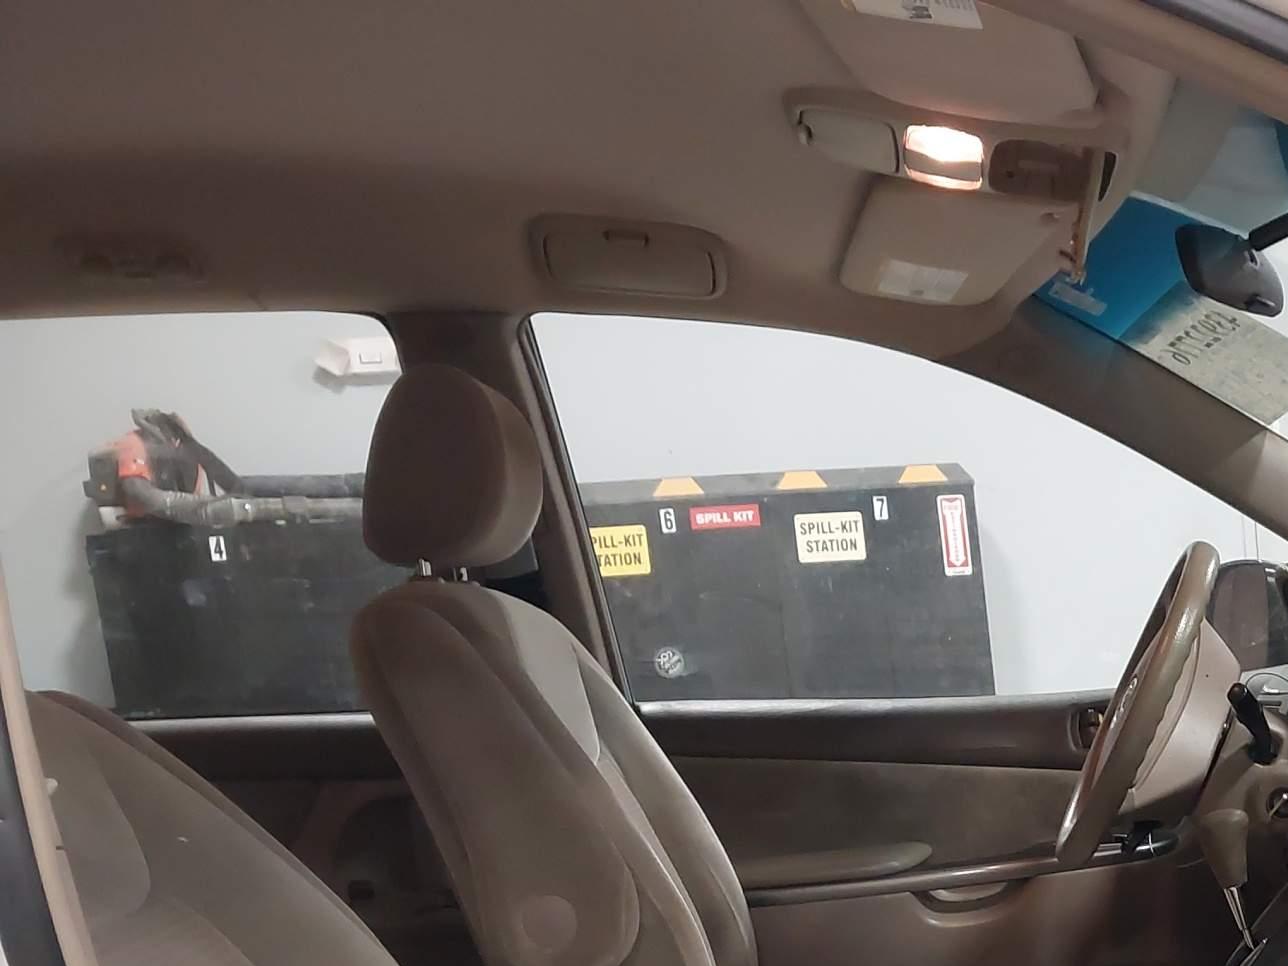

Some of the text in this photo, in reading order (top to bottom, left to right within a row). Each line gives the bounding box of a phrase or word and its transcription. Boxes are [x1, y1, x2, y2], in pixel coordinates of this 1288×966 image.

[875, 498, 885, 518] 7
[664, 511, 674, 530] 6
[695, 510, 755, 524] SPILL KIT
[799, 520, 860, 536] SPILL-KIT
[214, 536, 224, 559] 4
[592, 533, 645, 549] PILL-KIT
[805, 539, 858, 554] STATION
[599, 552, 643, 568] TATION
